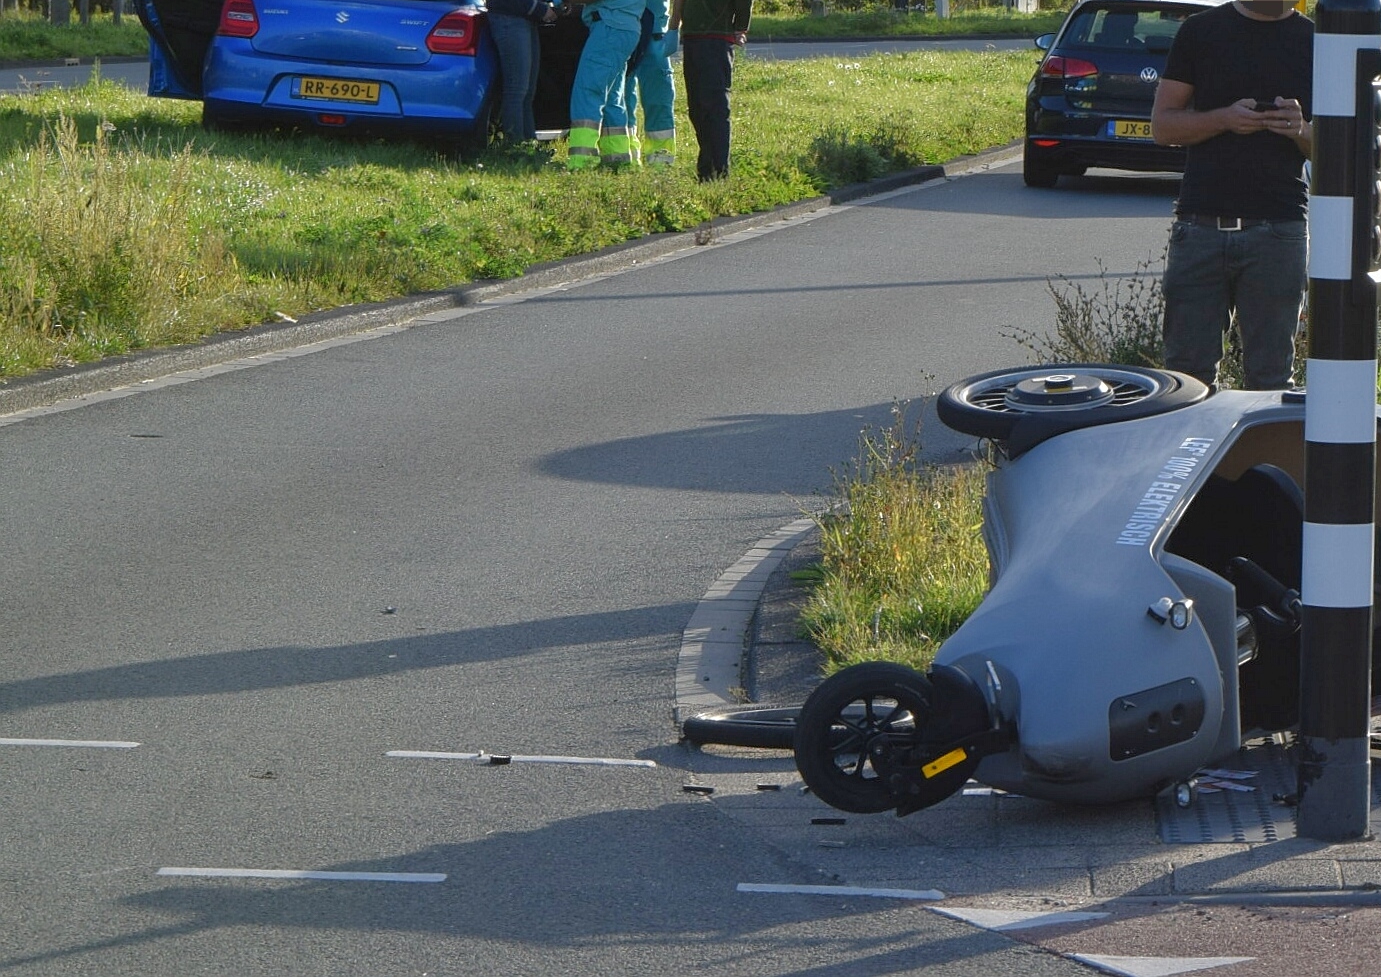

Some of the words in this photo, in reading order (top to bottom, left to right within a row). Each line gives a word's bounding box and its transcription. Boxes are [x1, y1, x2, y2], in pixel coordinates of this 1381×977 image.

[304, 80, 375, 99] RR-690-L
[1122, 123, 1151, 136] JX-8
[1158, 456, 1199, 480] 100%
[1115, 481, 1182, 546] ELEKTRISCH
